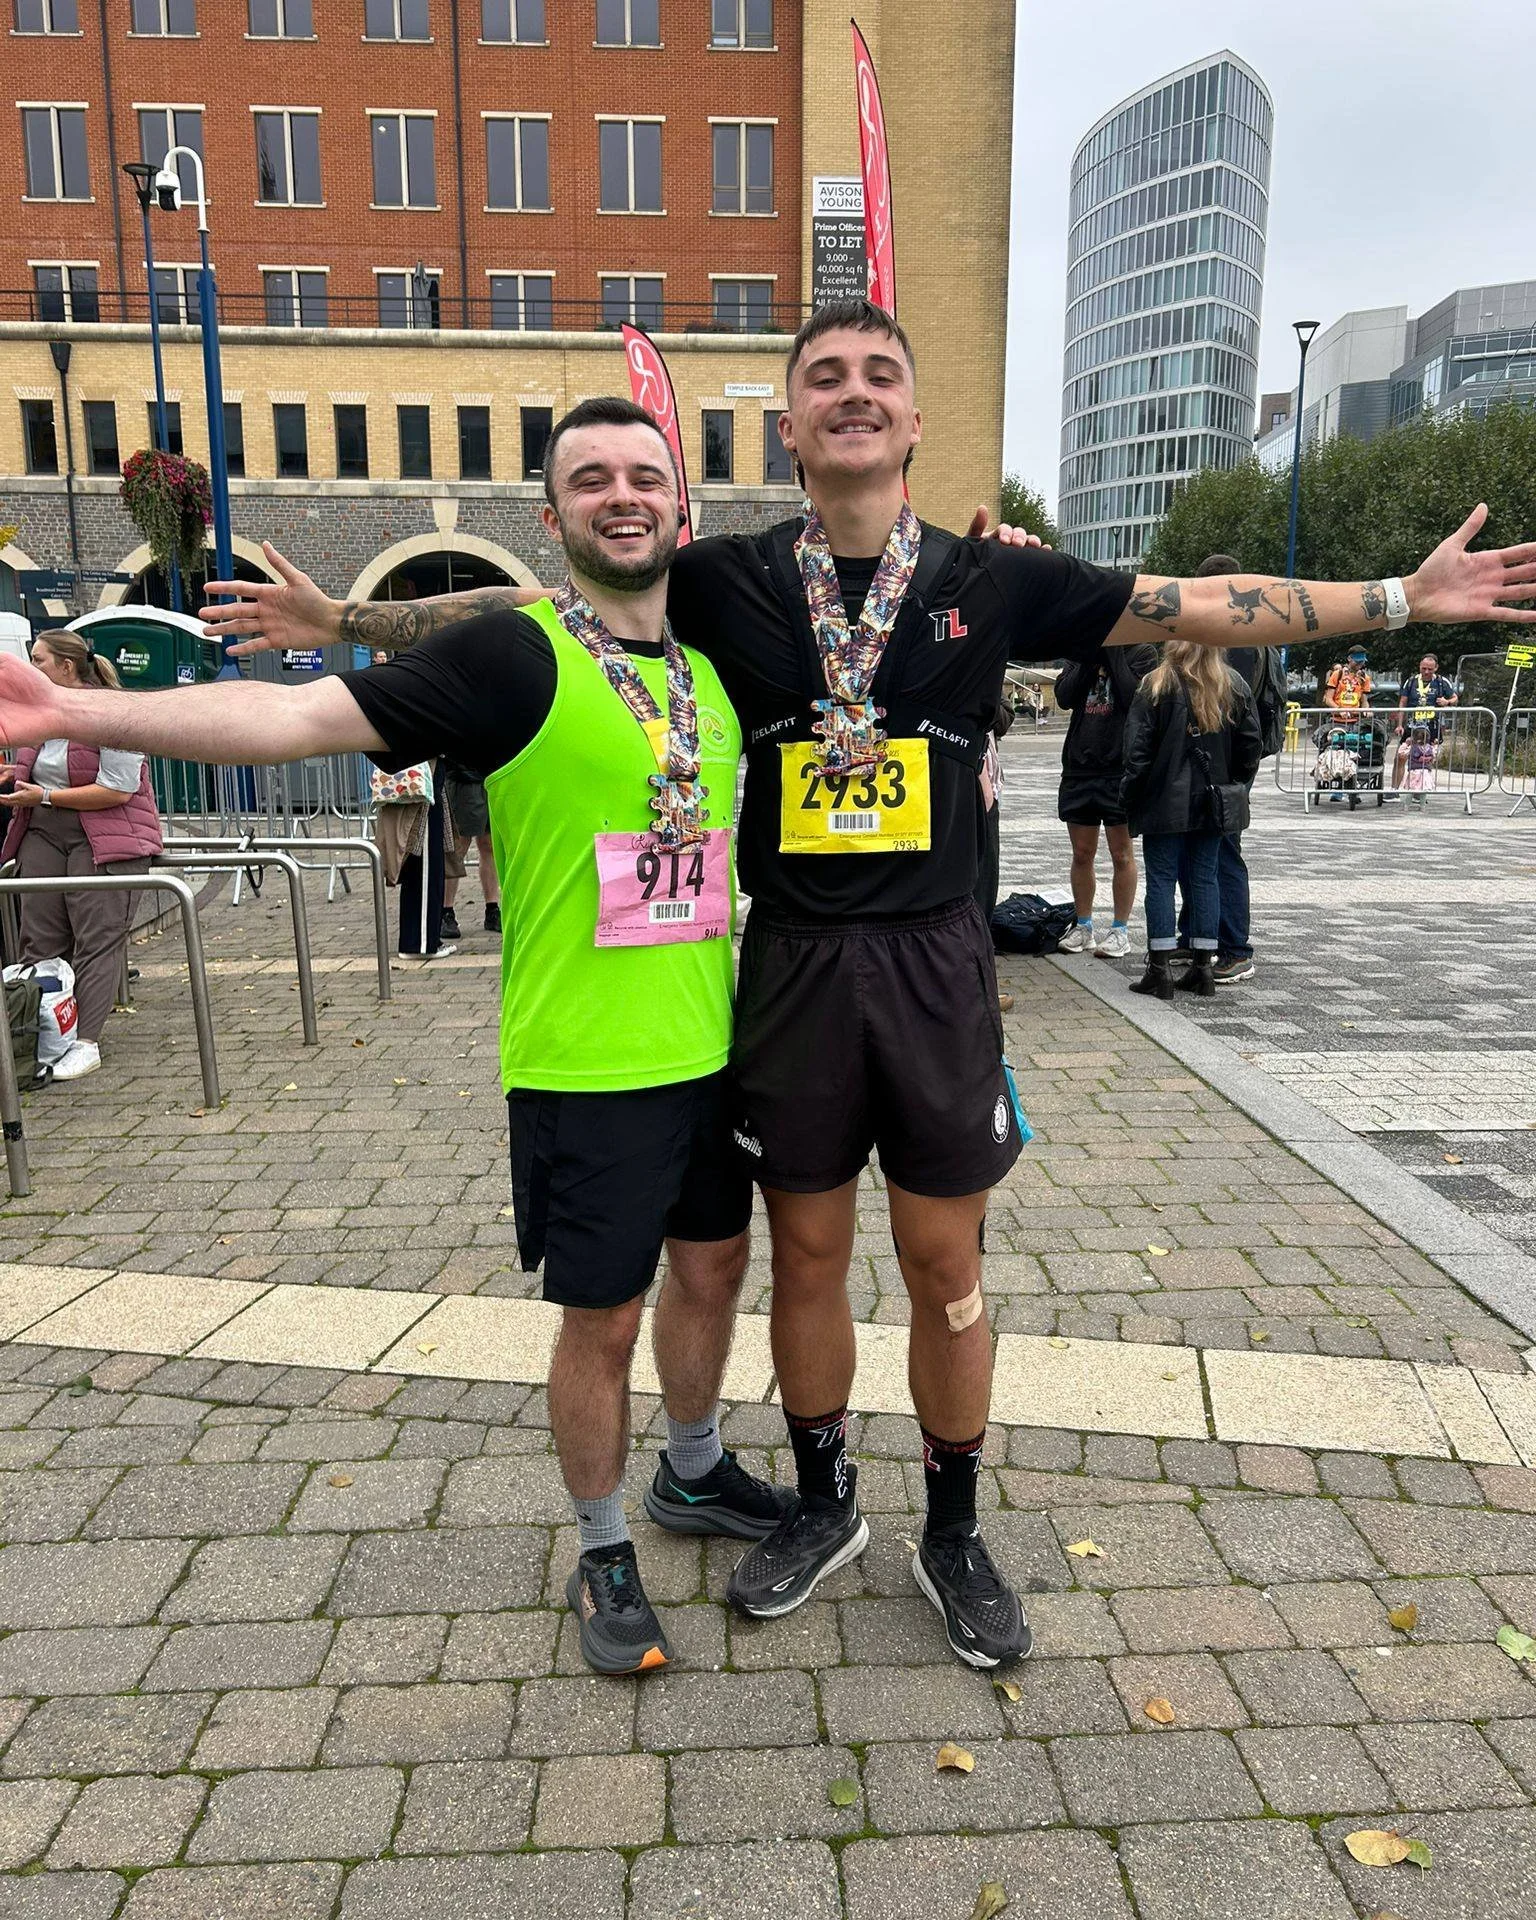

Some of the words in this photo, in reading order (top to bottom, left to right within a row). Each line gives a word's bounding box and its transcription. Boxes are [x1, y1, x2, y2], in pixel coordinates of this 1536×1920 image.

[820, 187, 862, 196] AVISON
[820, 198, 862, 207] YOUNG
[814, 223, 837, 231] Prime
[839, 223, 866, 231] Offices
[818, 237, 837, 248] TO
[839, 237, 862, 248] LET
[826, 254, 848, 262] 9,000
[817, 265, 844, 274] 40,000
[845, 267, 855, 275] sq
[856, 265, 863, 274] ft
[822, 276, 858, 285] Excellent
[814, 287, 844, 298] Parking
[845, 287, 866, 296] Ratio
[929, 608, 967, 642] TL
[754, 716, 796, 740] ZELAFIT
[927, 724, 970, 748] ZELAFIT
[800, 760, 907, 810] 2933
[893, 840, 919, 851] 2933
[636, 850, 705, 900] 914
[704, 927, 718, 939] 914
[733, 1128, 763, 1157] neills
